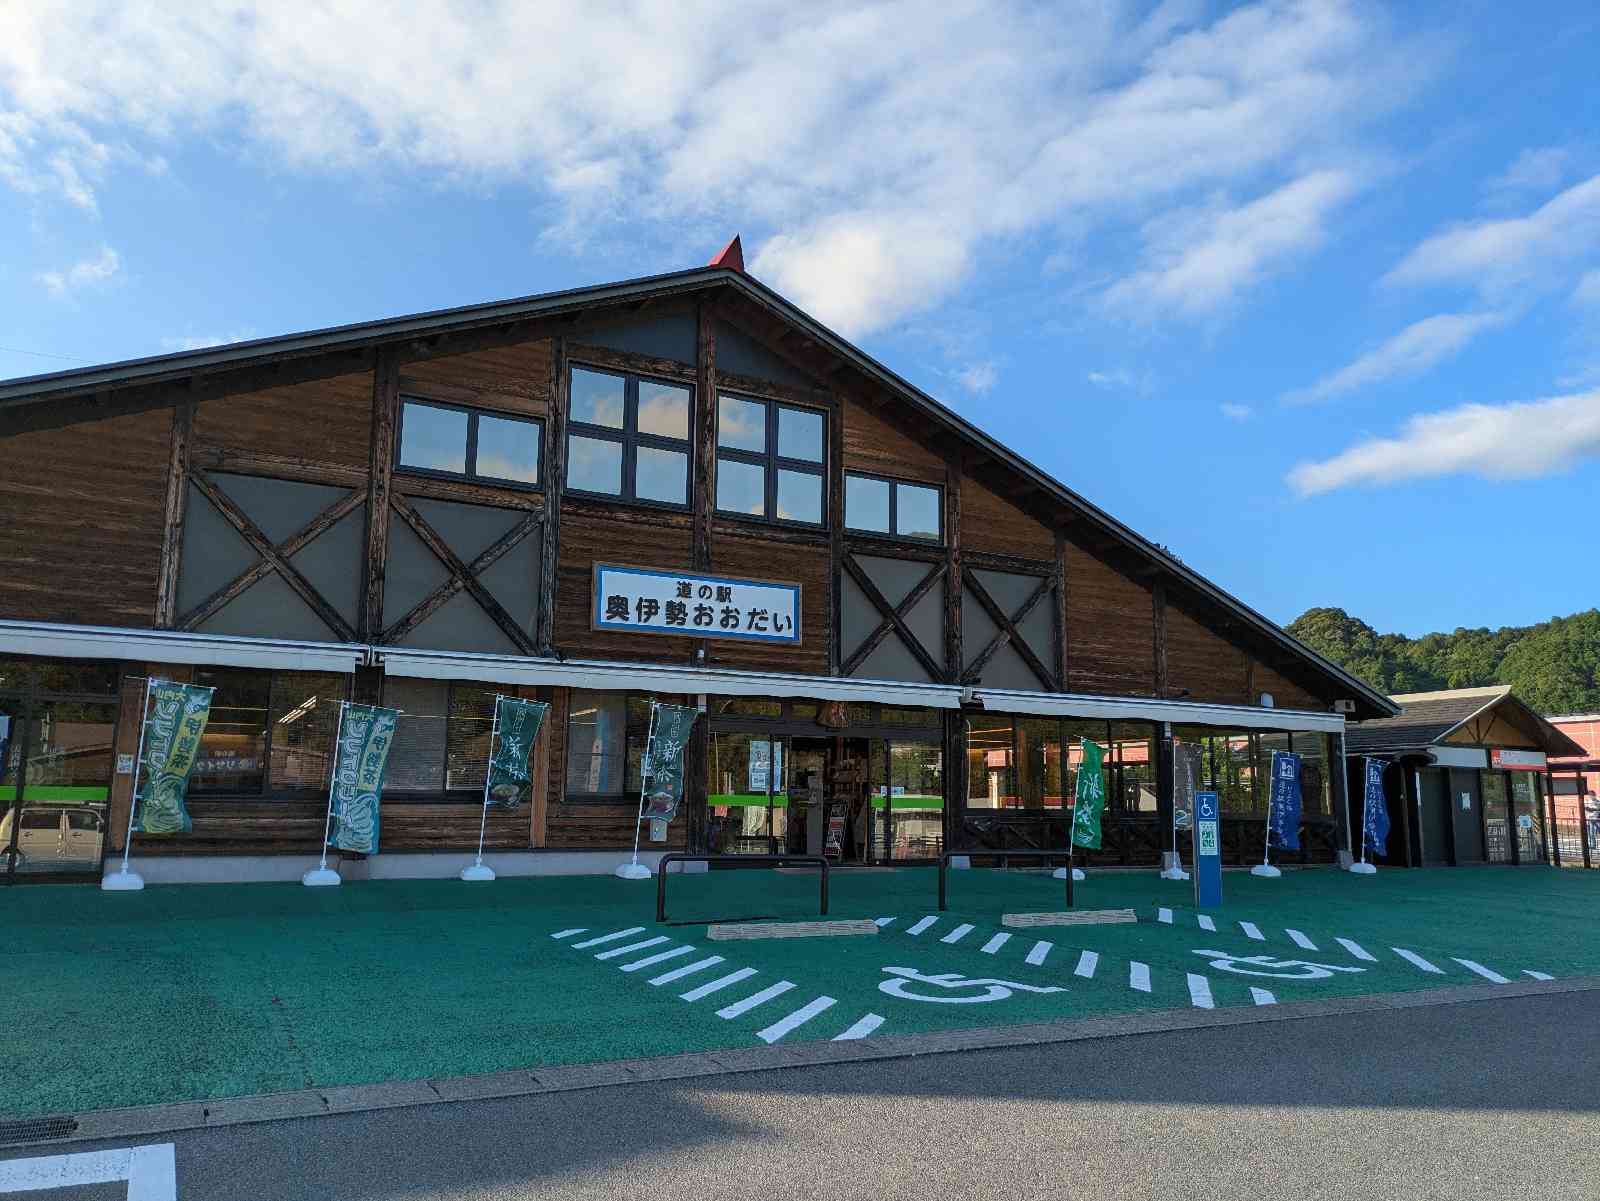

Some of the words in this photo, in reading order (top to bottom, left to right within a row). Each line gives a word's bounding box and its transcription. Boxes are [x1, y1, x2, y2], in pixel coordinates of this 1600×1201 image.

[676, 581, 732, 603] 道の駅
[605, 595, 792, 632] 奥伊勢おおだい
